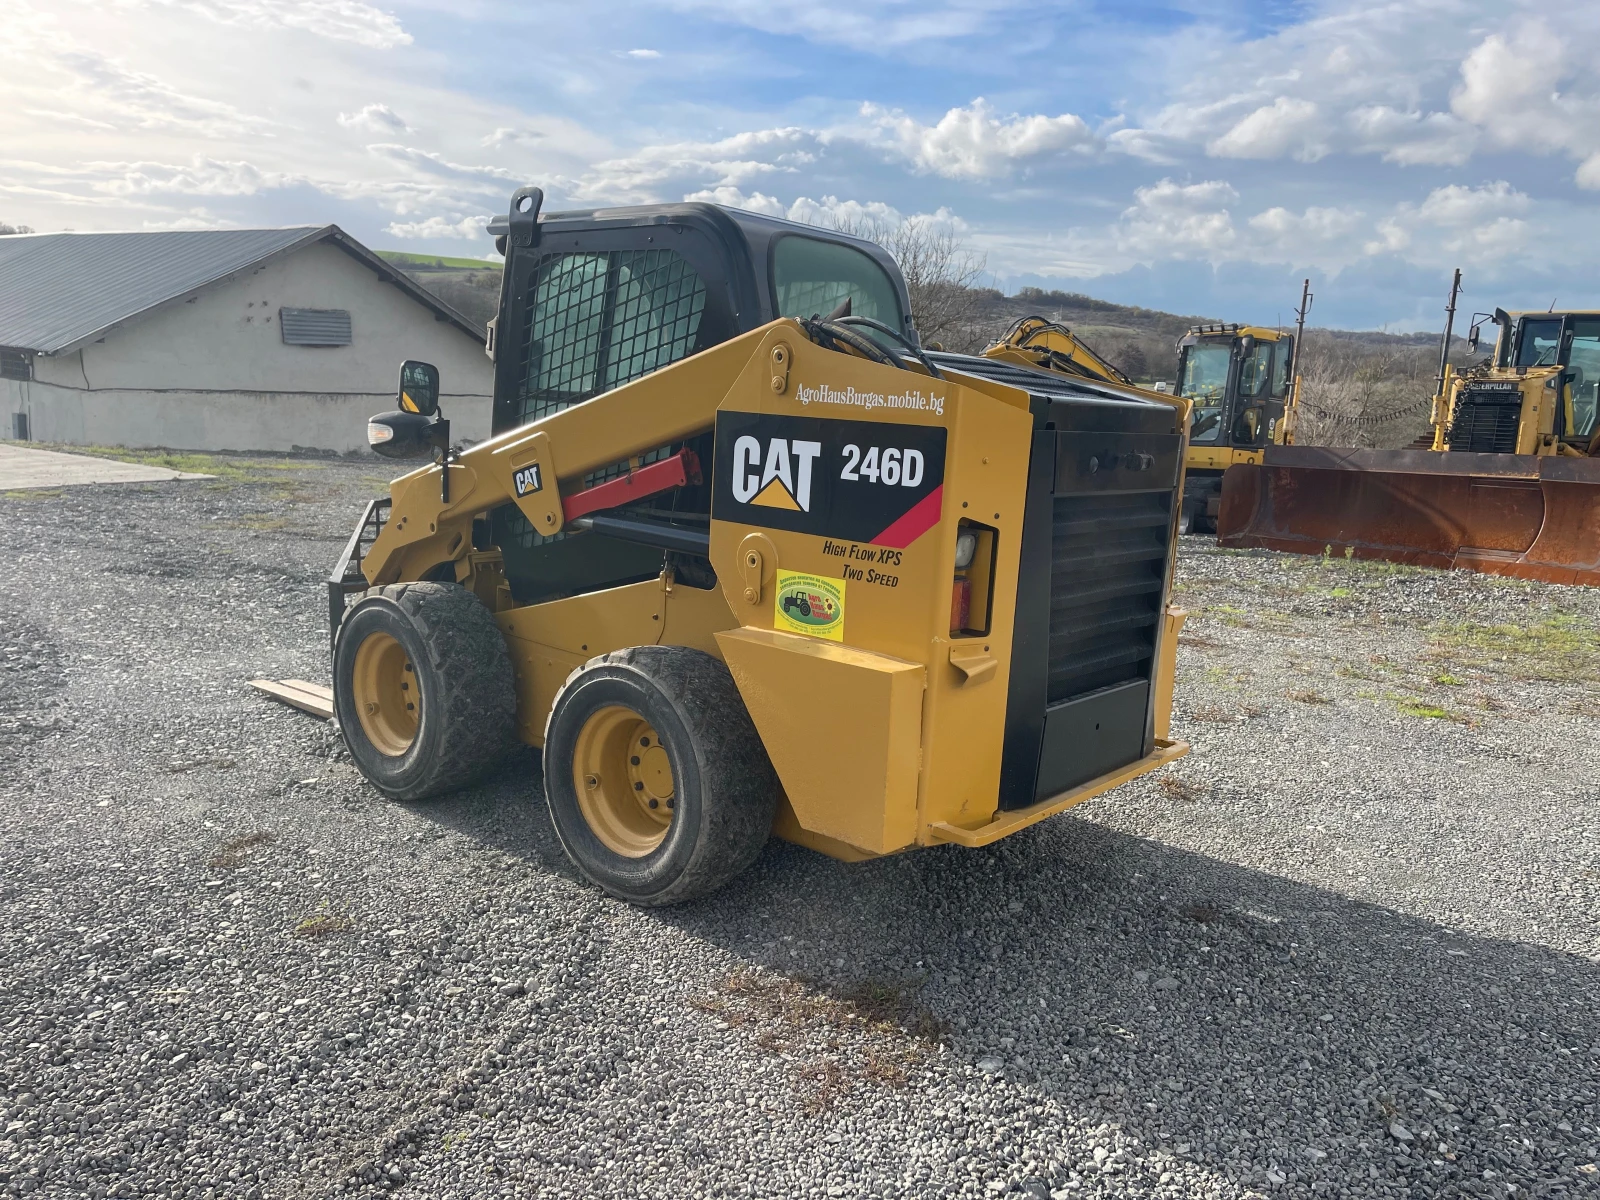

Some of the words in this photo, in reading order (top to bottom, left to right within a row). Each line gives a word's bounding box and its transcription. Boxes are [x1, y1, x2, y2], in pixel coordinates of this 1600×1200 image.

[795, 383, 945, 415] AgroHausBurgas.mobile.bg
[515, 466, 539, 494] CAT
[732, 435, 822, 513] CAT
[840, 444, 925, 488] 246D
[877, 549, 903, 566] XPS
